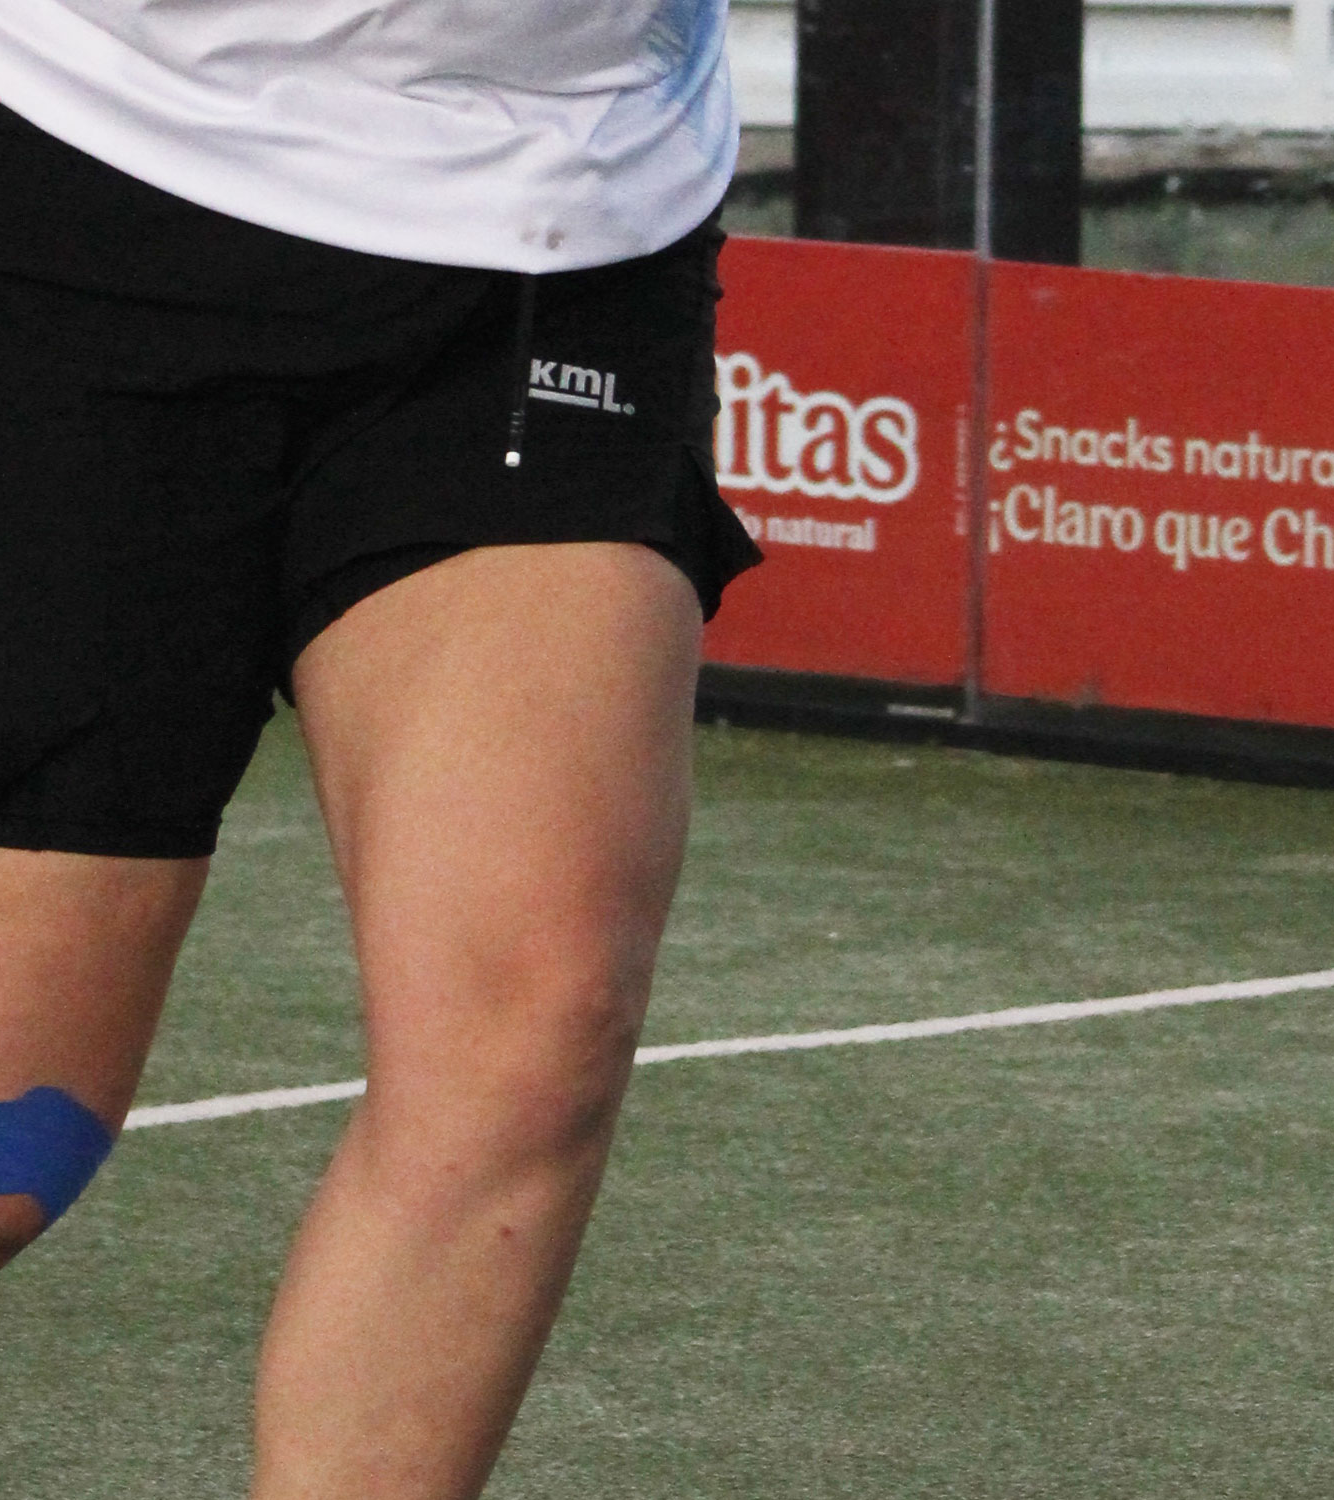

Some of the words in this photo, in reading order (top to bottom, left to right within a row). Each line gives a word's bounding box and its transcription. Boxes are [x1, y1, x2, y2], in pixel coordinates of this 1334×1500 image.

[989, 408, 1174, 473] ¿Snacks
[987, 483, 1145, 554] ¡Claro
[1153, 513, 1250, 571] que
